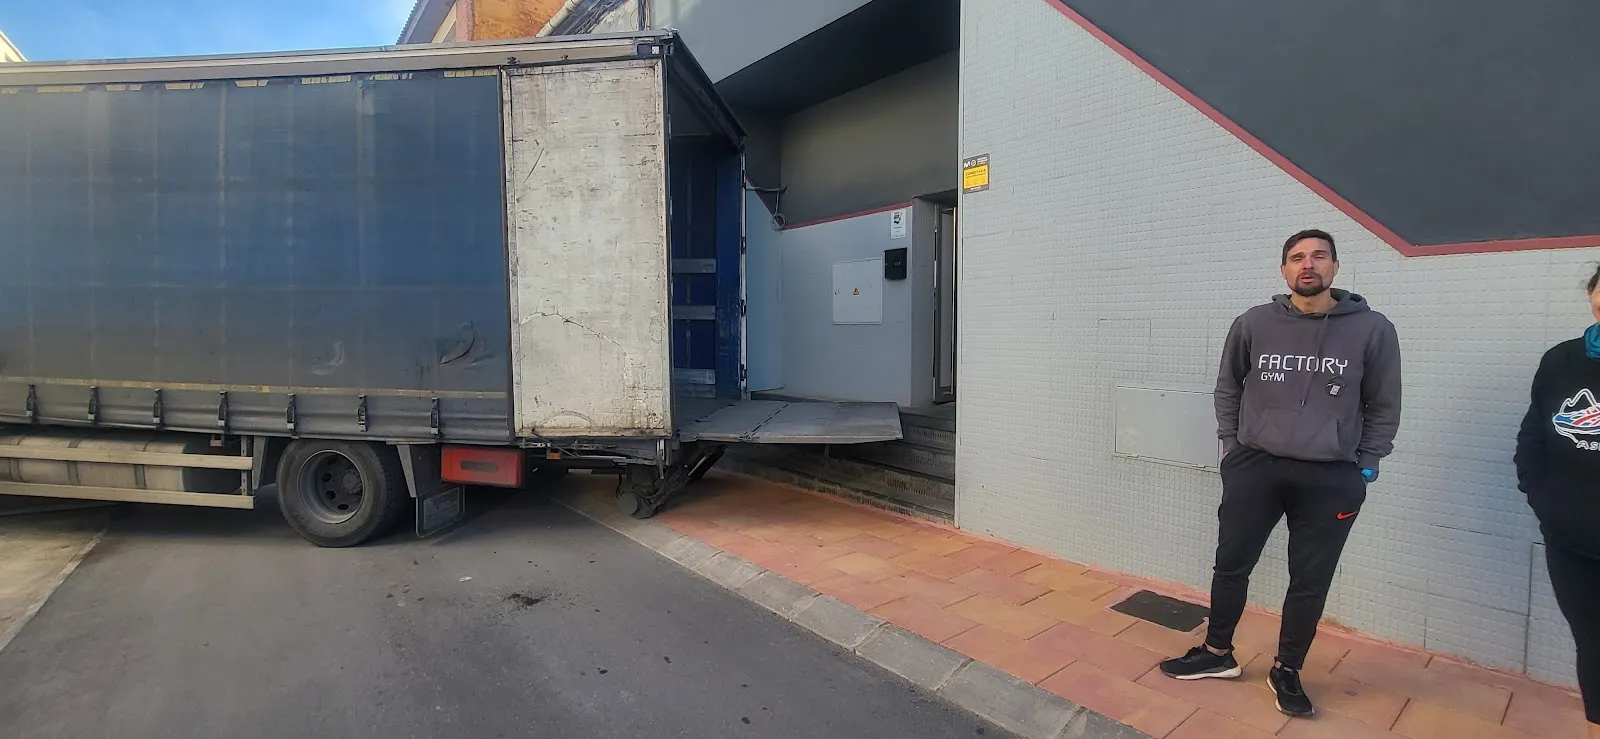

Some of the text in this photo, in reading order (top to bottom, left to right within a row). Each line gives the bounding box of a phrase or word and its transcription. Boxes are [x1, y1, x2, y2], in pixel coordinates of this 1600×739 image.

[1258, 354, 1348, 375] FACTORY
[1261, 371, 1285, 382] GYM
[1576, 440, 1600, 451] AS
